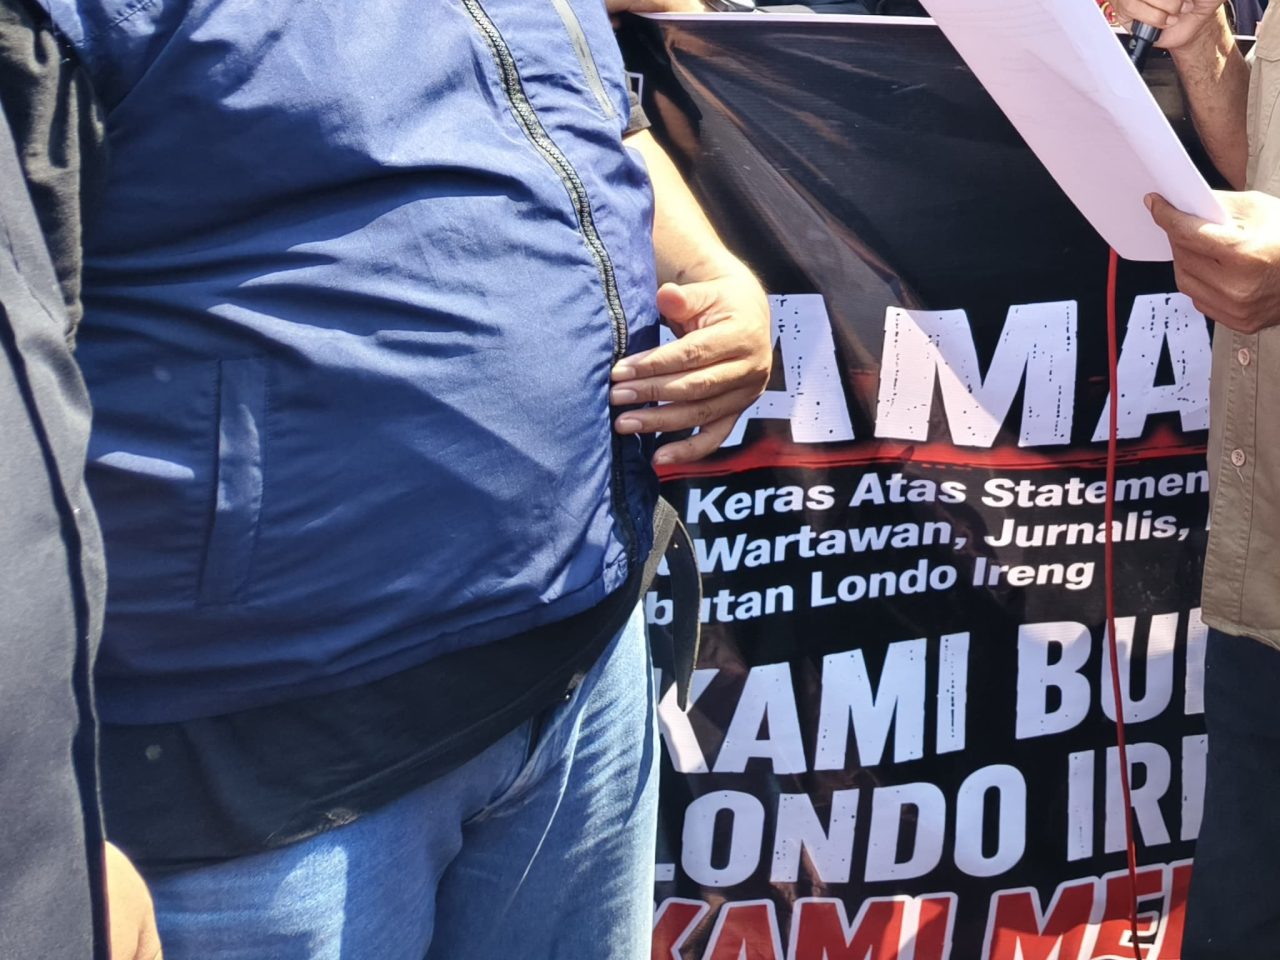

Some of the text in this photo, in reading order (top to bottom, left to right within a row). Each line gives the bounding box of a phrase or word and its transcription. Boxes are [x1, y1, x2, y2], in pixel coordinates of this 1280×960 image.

[655, 292, 1212, 446] AMA
[686, 470, 1210, 524] Keras Atas Statemen
[694, 520, 965, 574] Wartawan,
[983, 510, 1190, 548] Jurnalis,
[811, 559, 957, 607] Londo
[973, 557, 1095, 590] Ireng
[652, 632, 970, 774] KAMI
[654, 764, 1027, 887] ONDO
